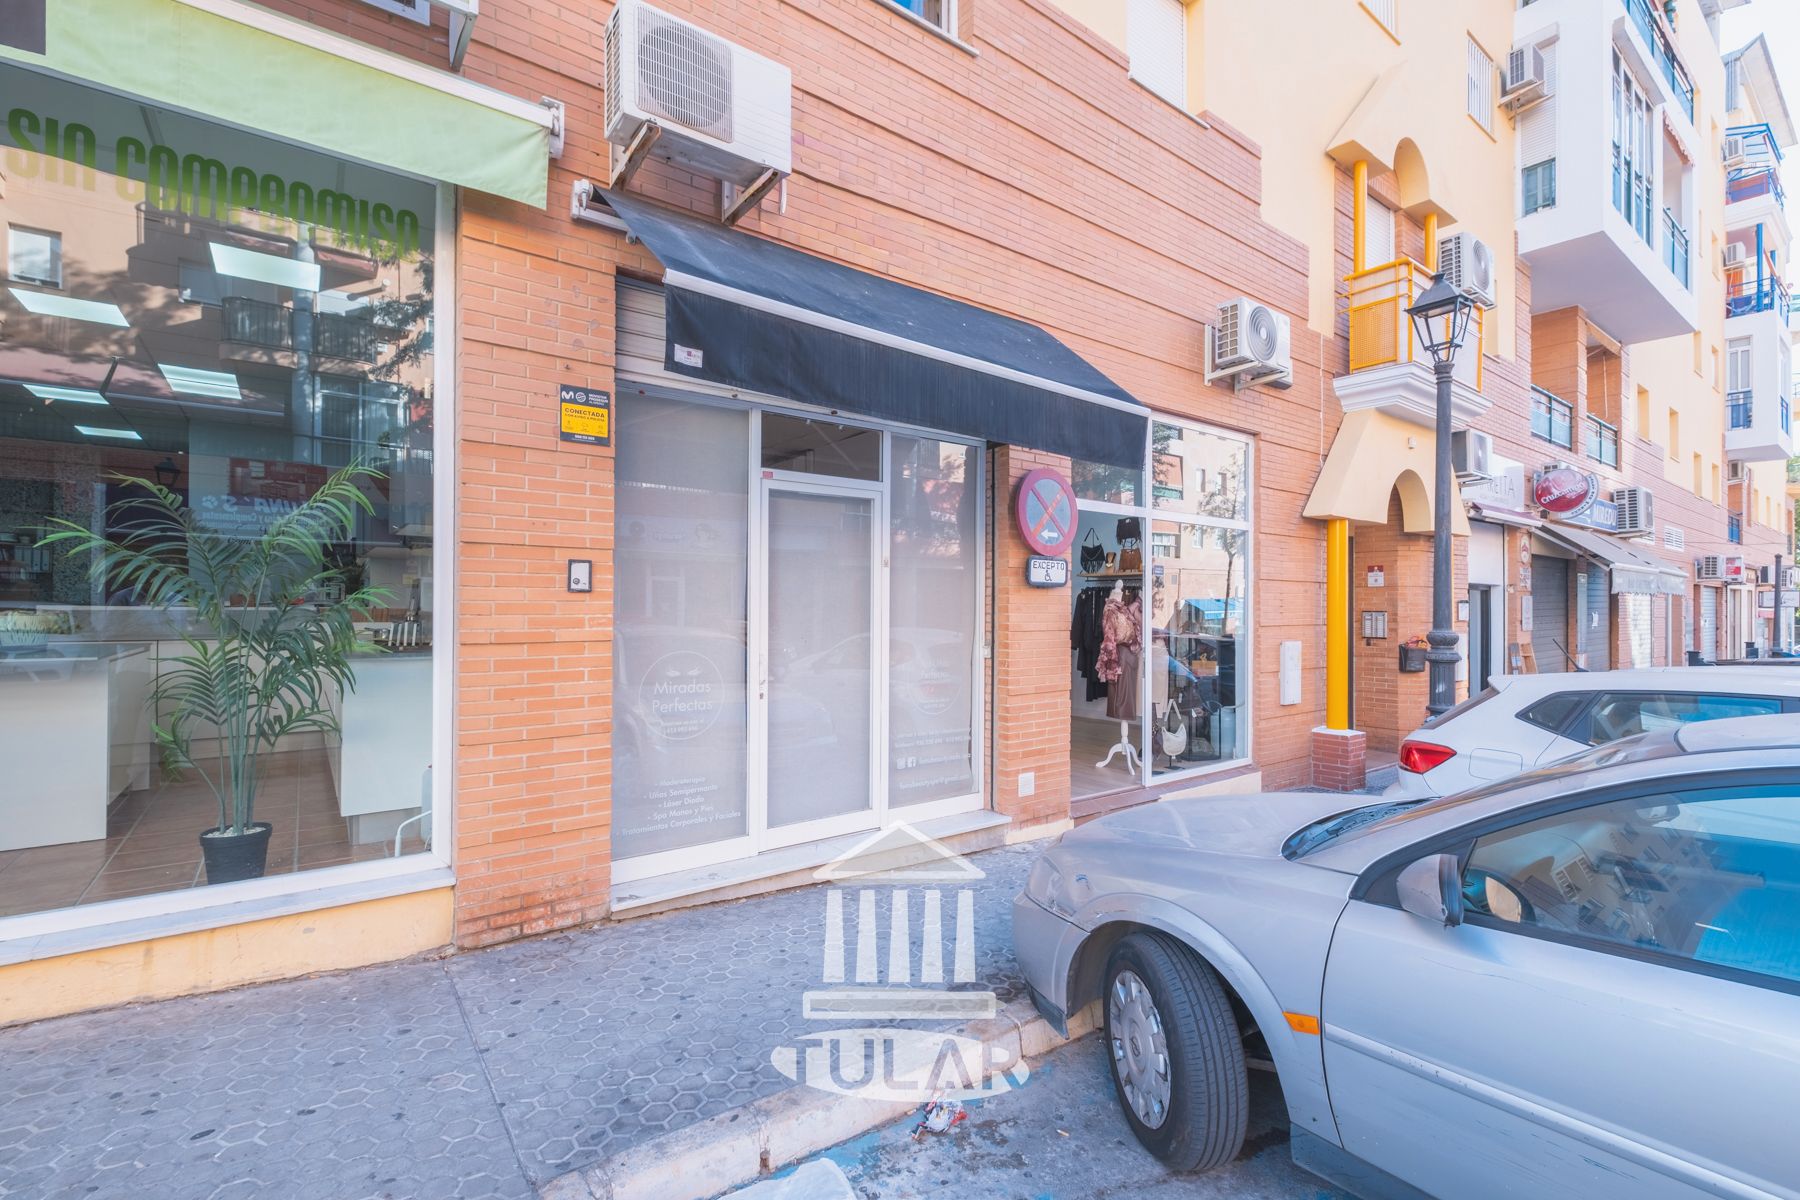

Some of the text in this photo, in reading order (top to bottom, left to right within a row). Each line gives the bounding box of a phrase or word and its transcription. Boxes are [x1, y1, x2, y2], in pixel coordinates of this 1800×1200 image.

[564, 407, 605, 418] CONECTADA
[1032, 560, 1065, 571] EXCEPTO
[654, 680, 711, 695] Miradas
[652, 697, 713, 713] Perfectas
[652, 812, 667, 821] Spa
[669, 810, 693, 818] Manos
[622, 823, 668, 836] Tratamientos
[670, 817, 708, 829] Corporales
